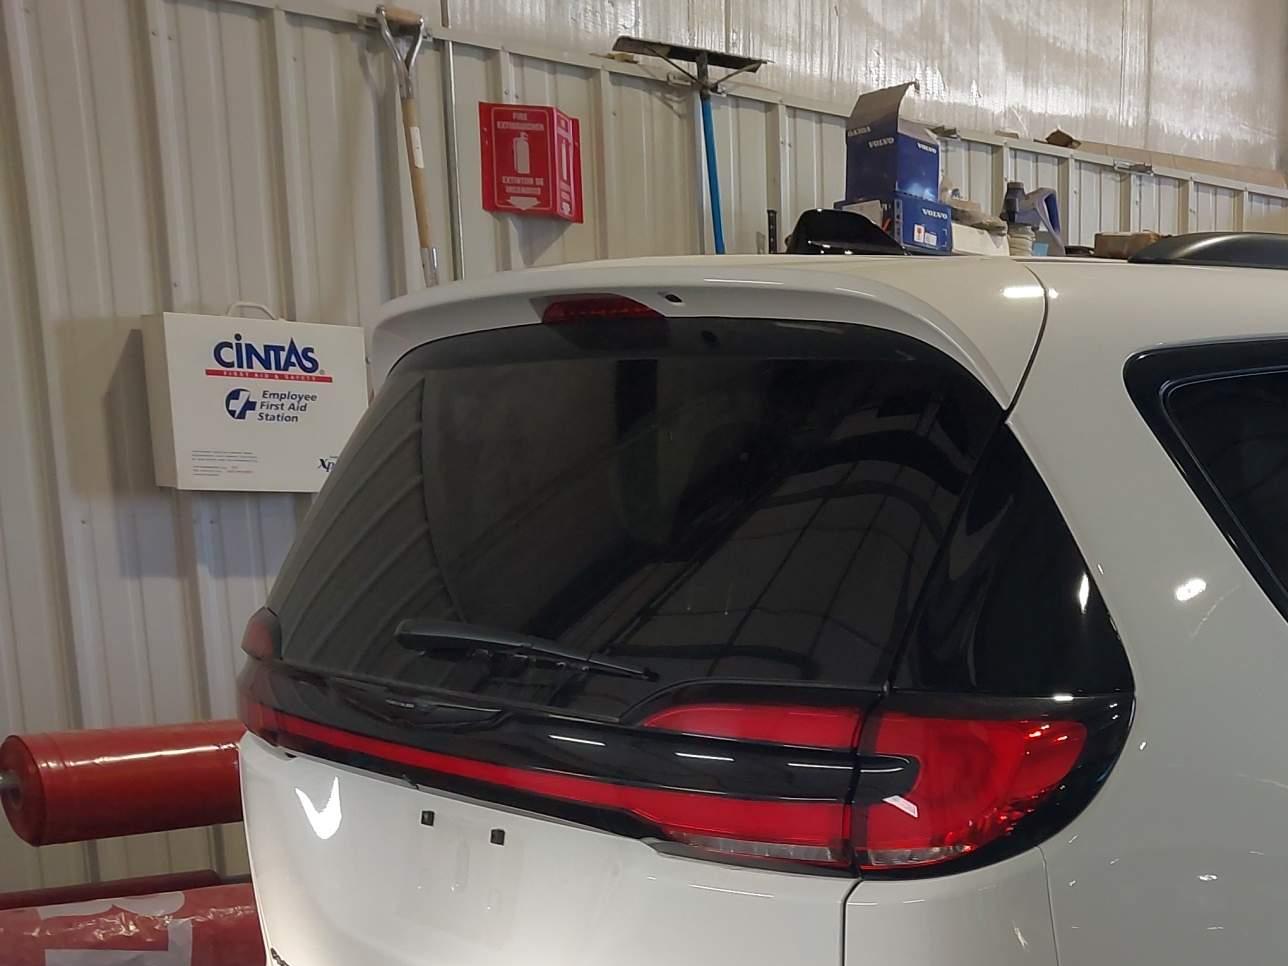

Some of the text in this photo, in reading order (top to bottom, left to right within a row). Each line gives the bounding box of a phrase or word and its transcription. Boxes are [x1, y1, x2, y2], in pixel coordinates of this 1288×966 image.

[868, 137, 895, 149] VOLVO
[917, 142, 937, 154] VOLVO
[922, 208, 948, 220] VOLVO
[262, 390, 317, 403] Employee
[260, 401, 307, 412] First Aid
[257, 413, 299, 423] Station
